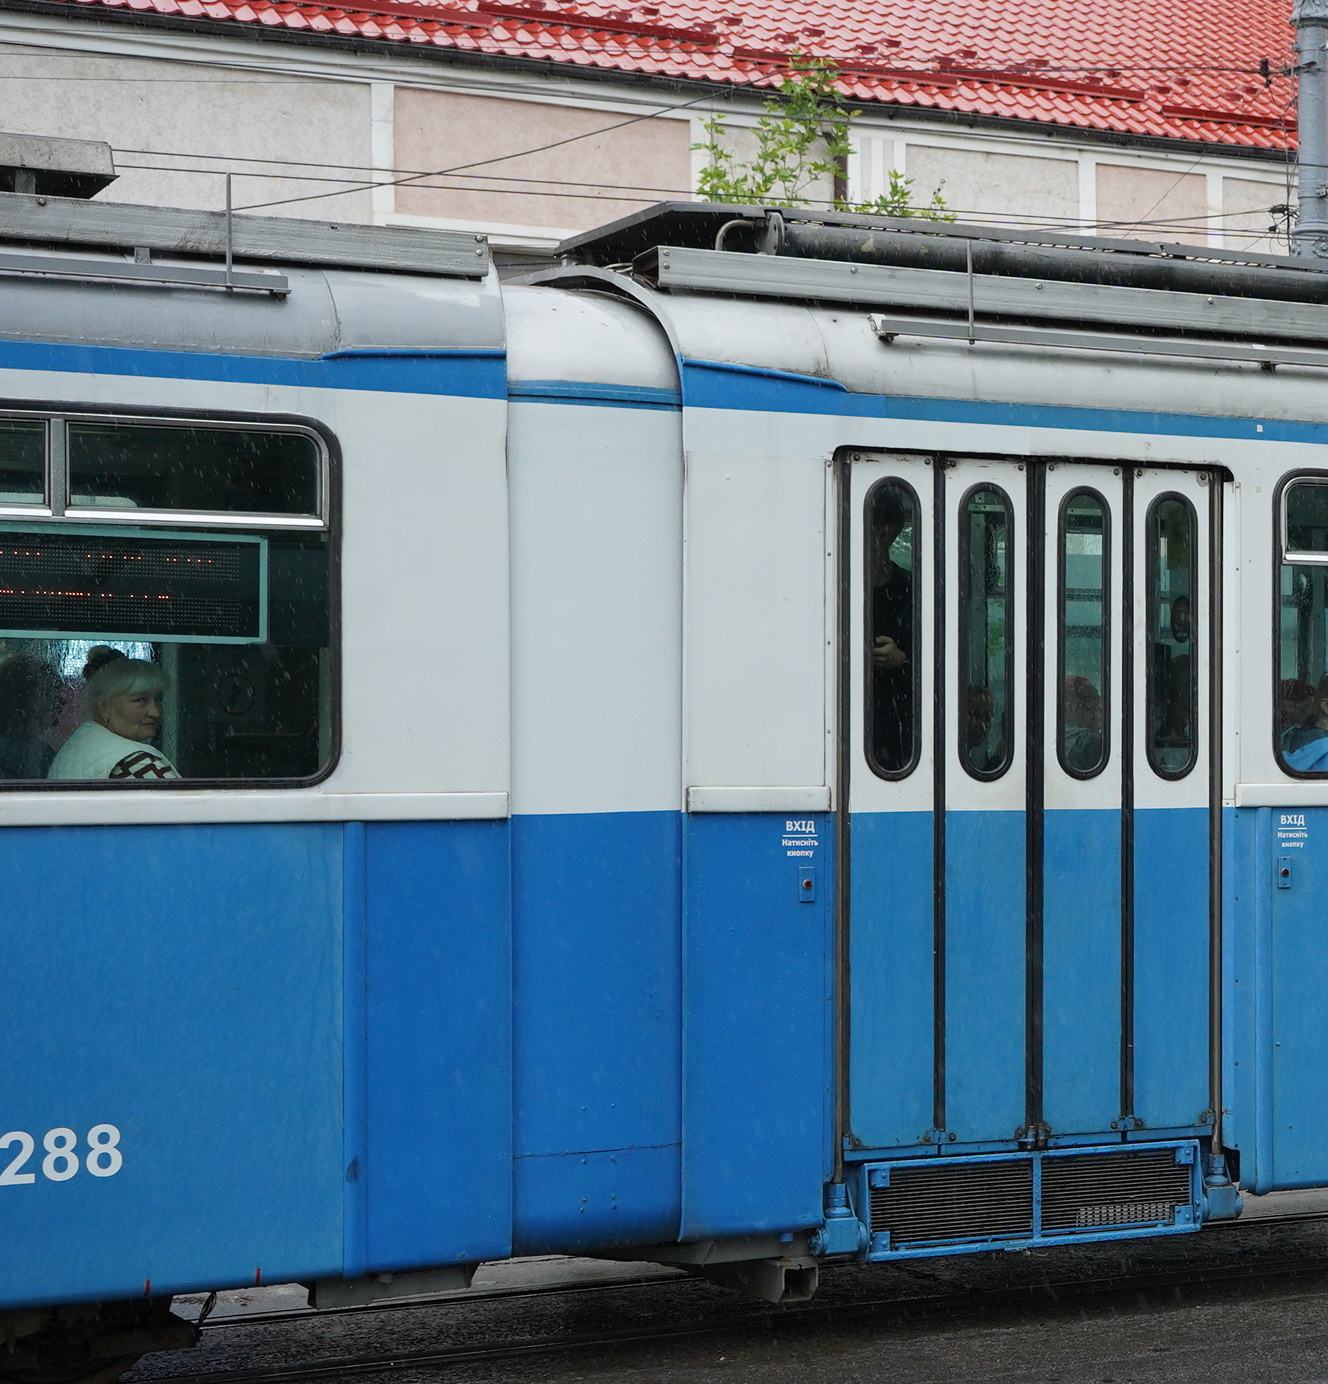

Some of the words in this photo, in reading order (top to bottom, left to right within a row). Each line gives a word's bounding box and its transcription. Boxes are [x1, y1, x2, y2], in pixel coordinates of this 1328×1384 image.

[785, 820, 816, 834] ВХІД
[1280, 814, 1305, 826] ВХІД
[0, 1124, 123, 1186] 288
